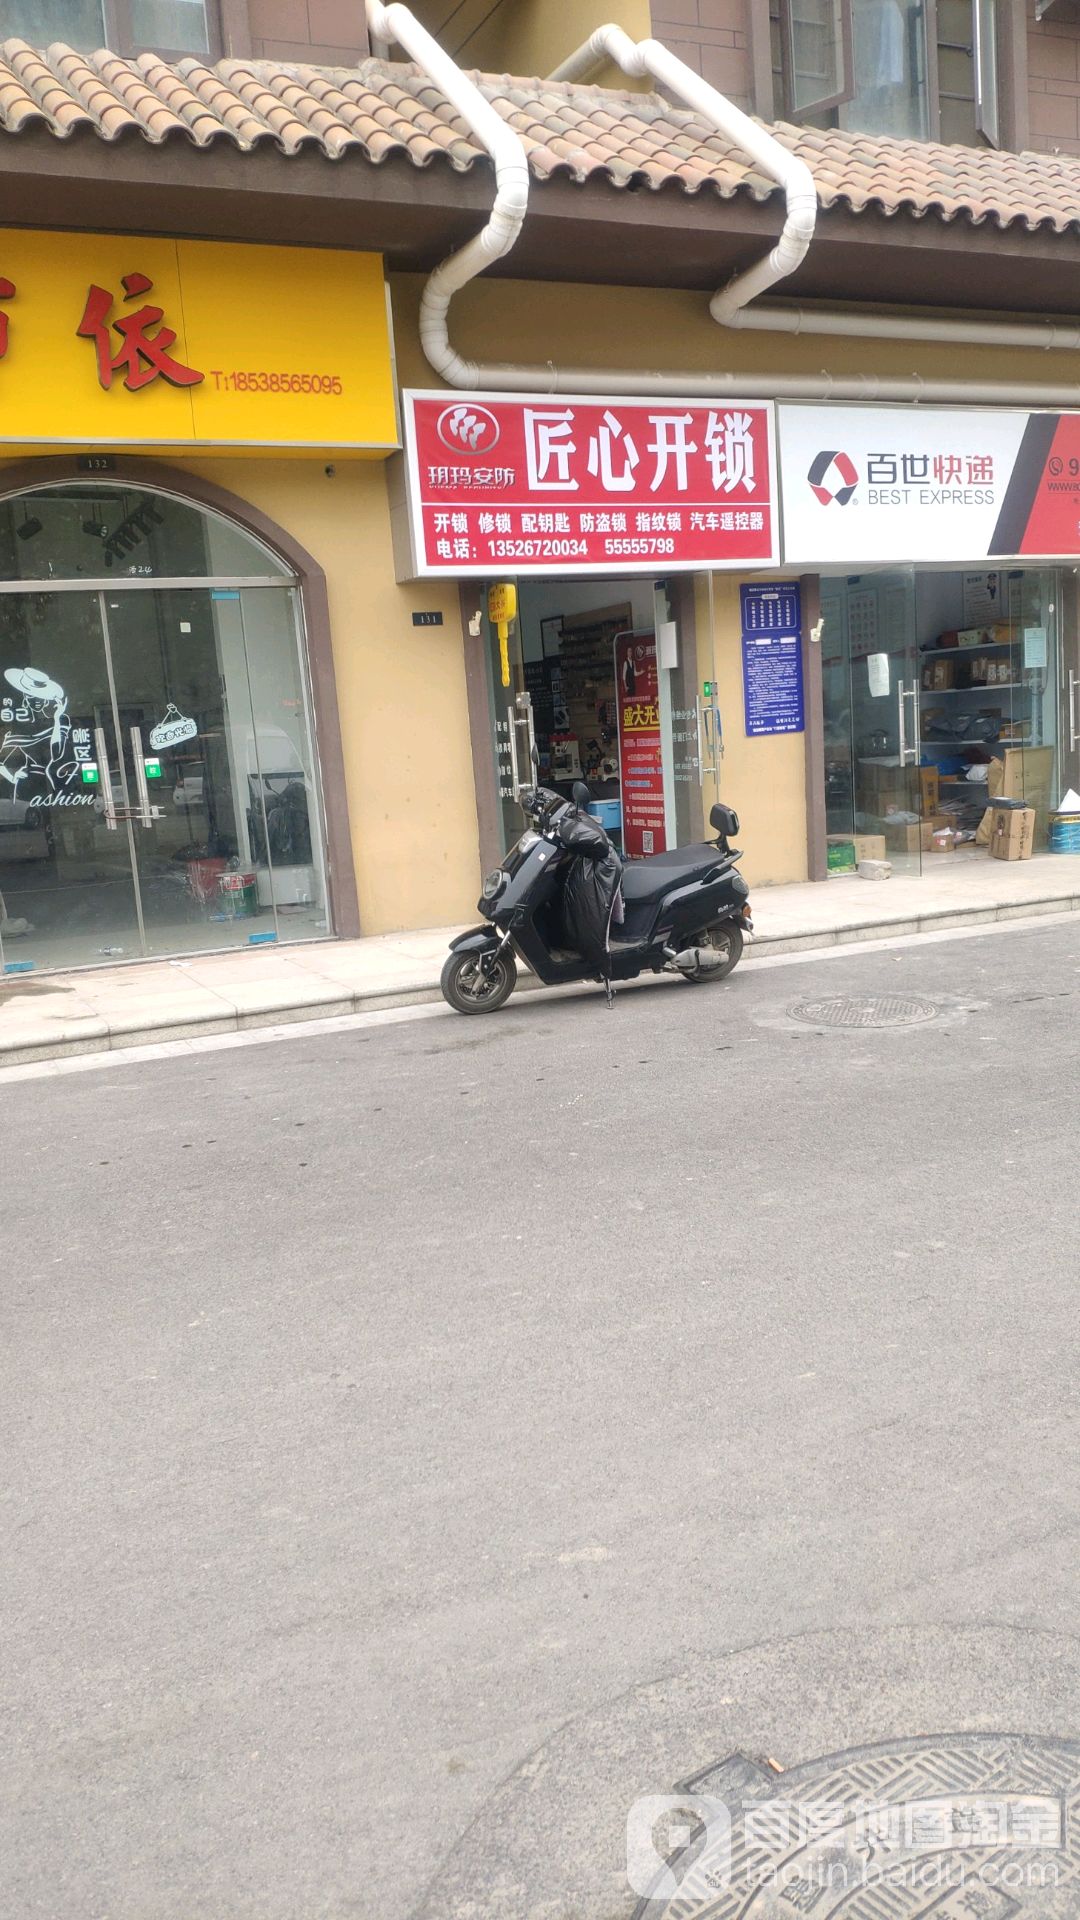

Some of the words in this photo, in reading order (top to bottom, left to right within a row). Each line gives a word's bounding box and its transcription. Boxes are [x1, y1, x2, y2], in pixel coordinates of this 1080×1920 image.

[0, 271, 205, 392] 依
[523, 407, 757, 494] 匠心开锁
[88, 459, 108, 469] 132
[867, 453, 994, 485] 百世快递
[868, 490, 911, 505] BEST
[920, 489, 994, 505] EXPRESS
[434, 512, 469, 533] 开锁
[478, 512, 512, 533] 修锁
[521, 512, 570, 533] 配钥匙
[580, 512, 627, 532] 防盗锁
[636, 512, 682, 532] 指纹锁
[690, 511, 764, 531] 汽车遥控器
[487, 539, 588, 557] 13526720034
[605, 538, 674, 555] 55555798
[420, 615, 436, 624] 131
[0, 707, 30, 722] 自己
